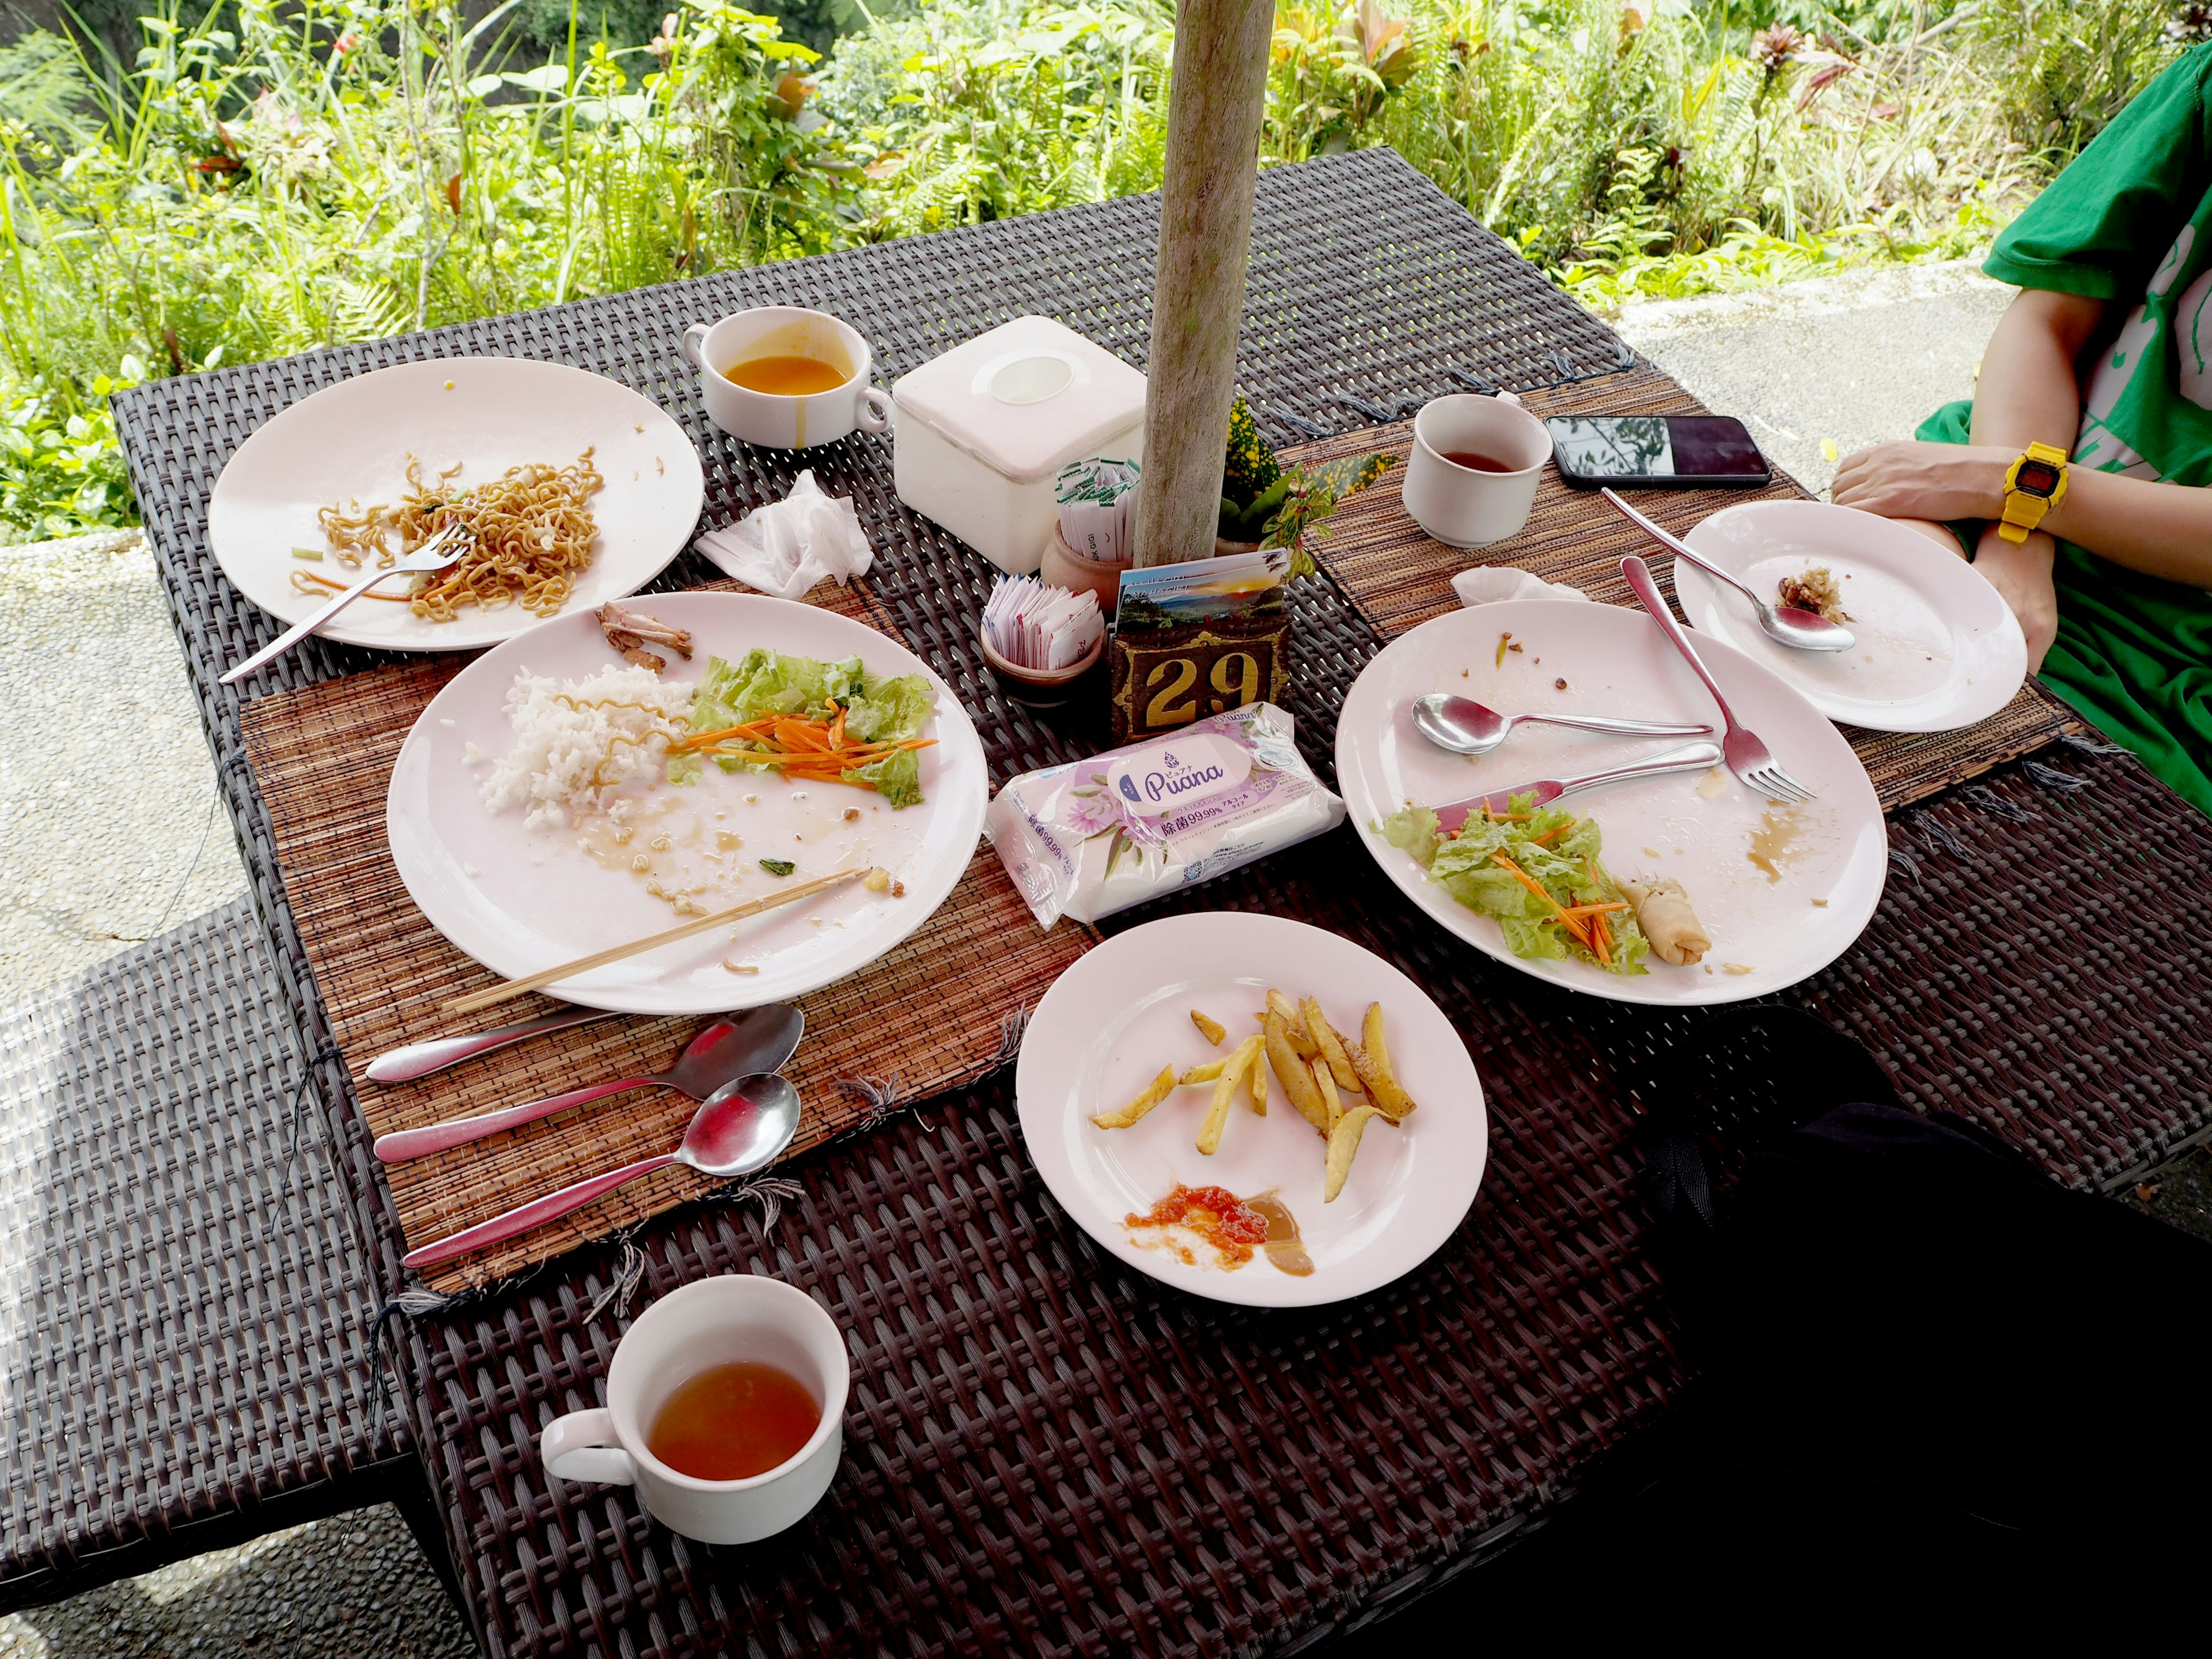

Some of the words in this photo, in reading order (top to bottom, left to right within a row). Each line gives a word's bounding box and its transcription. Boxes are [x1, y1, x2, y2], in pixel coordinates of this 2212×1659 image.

[1088, 533, 1096, 549] GIGI
[1146, 653, 1258, 727] 29
[1215, 712, 1256, 724] Puana
[1165, 765, 1193, 778] ピュアナ
[1145, 765, 1224, 801] Puana
[1221, 794, 1248, 806] アルコール
[1232, 801, 1244, 809] タイプ
